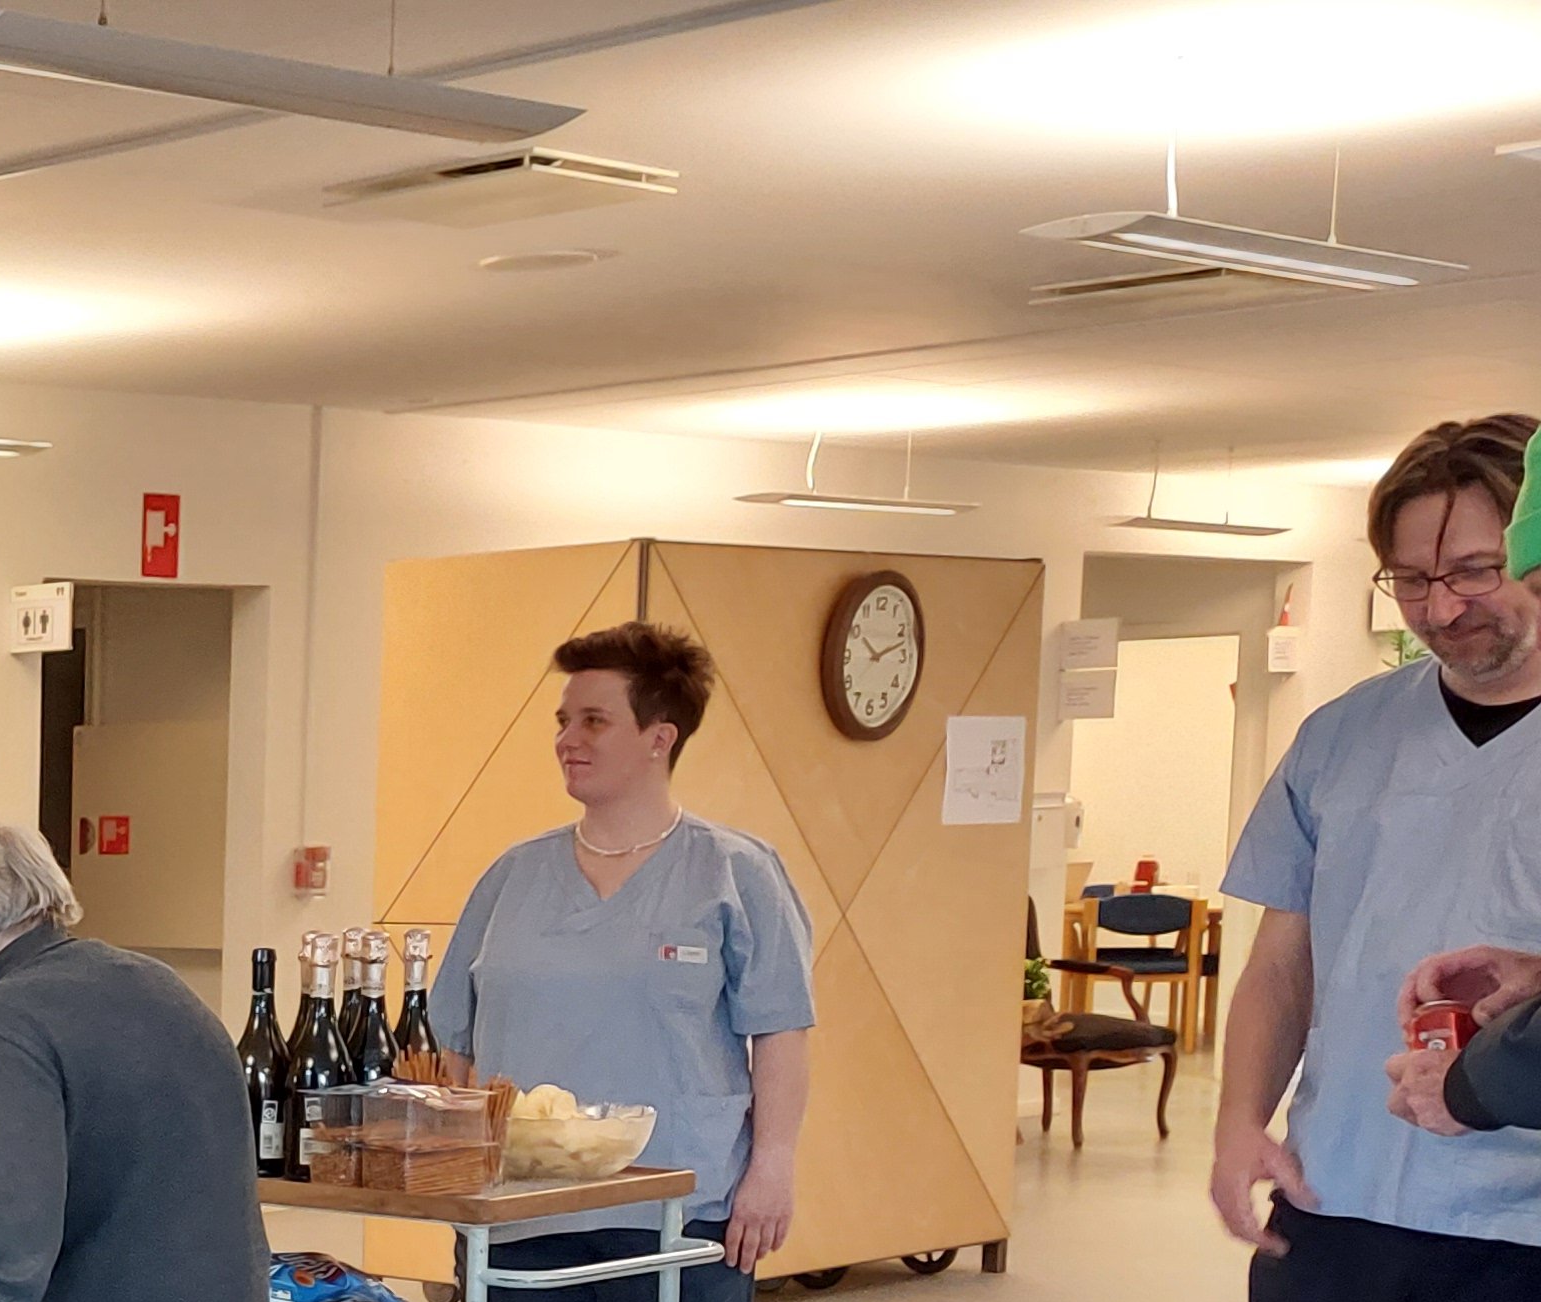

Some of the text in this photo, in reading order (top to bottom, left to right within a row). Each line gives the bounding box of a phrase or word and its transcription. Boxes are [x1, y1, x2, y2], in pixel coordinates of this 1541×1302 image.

[876, 596, 888, 611] 12
[897, 623, 906, 638] 2
[898, 648, 907, 664] 3
[891, 673, 900, 689] 4
[853, 691, 862, 709] 7
[865, 698, 874, 716] 6
[879, 691, 888, 709] 5
